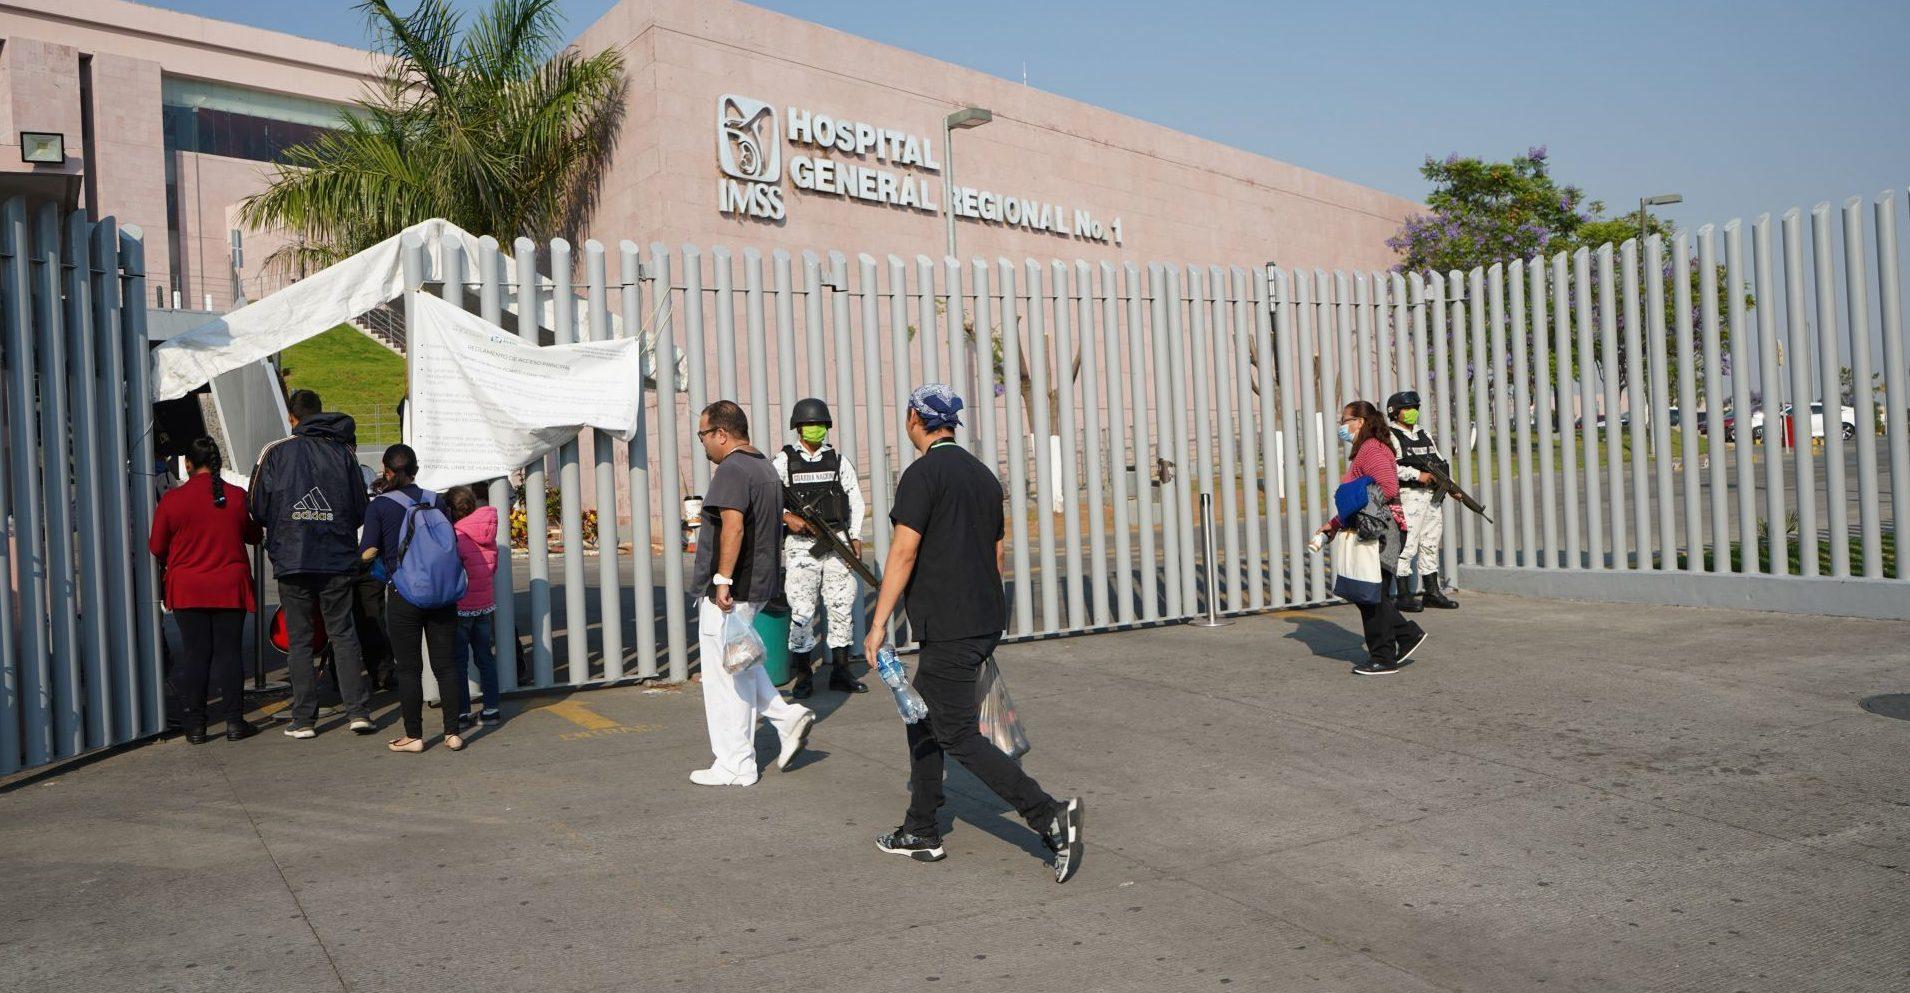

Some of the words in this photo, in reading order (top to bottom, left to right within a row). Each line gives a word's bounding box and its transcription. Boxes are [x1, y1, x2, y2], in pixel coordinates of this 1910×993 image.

[787, 106, 940, 170] HOSPITAL
[718, 177, 786, 219] IMSS
[790, 155, 938, 211] GENERAL
[944, 183, 1070, 234] REGIONAL
[1111, 216, 1123, 243] 1
[291, 510, 334, 521] adidas
